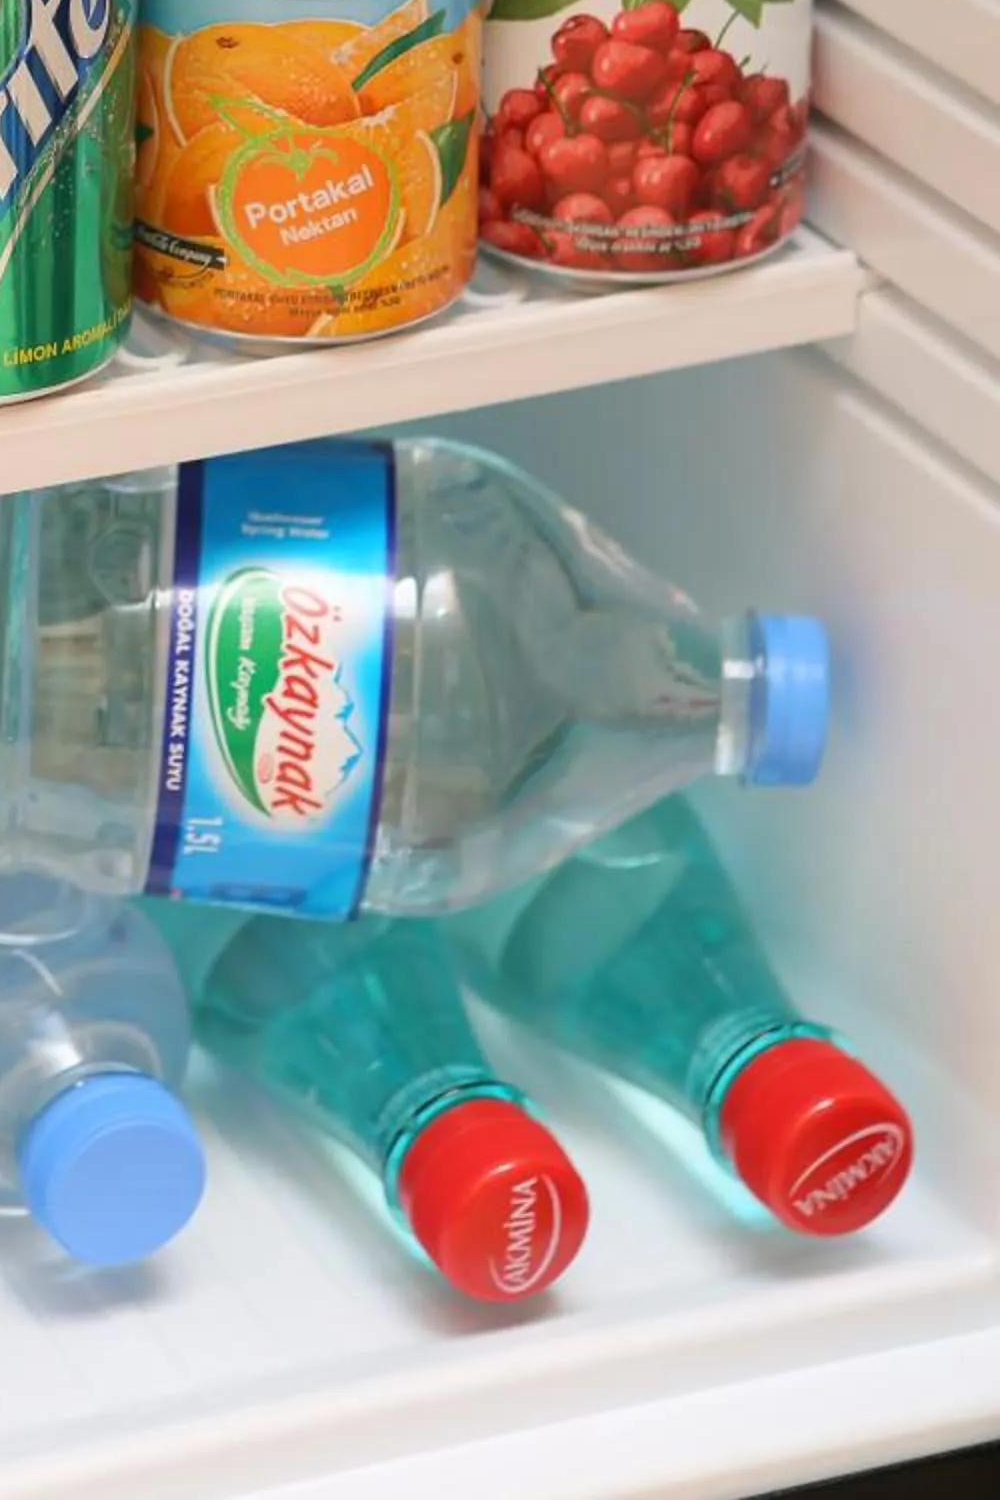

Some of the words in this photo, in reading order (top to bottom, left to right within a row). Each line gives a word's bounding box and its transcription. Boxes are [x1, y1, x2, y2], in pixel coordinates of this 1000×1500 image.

[244, 163, 374, 229] Portakal
[170, 660, 190, 738] KAYNAK
[266, 584, 342, 818] Özkaynak
[165, 743, 184, 792] SUYU
